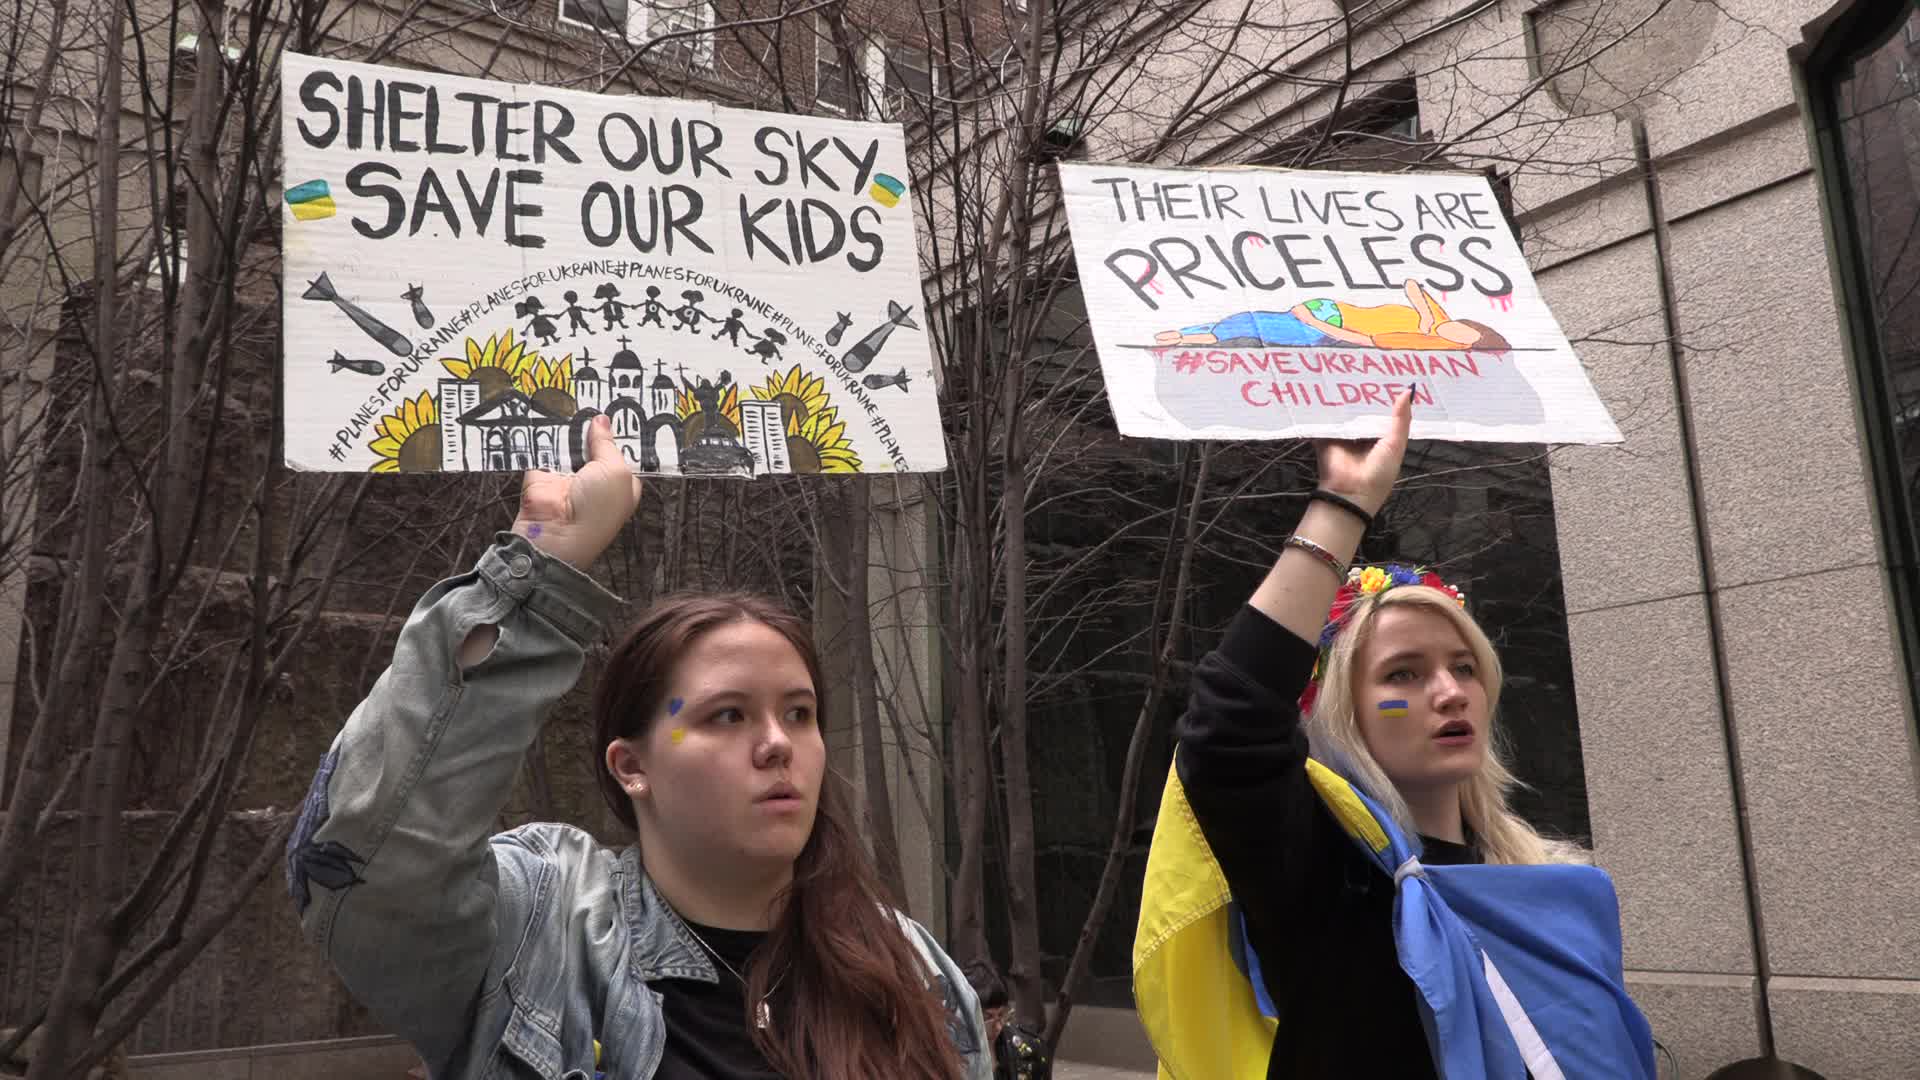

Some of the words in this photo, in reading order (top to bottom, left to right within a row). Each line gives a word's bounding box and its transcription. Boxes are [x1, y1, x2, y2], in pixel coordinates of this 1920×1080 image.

[297, 70, 583, 164] SHELTER
[599, 112, 732, 178] OUR
[754, 126, 879, 195] SKY
[346, 161, 546, 248] SAVE
[581, 181, 714, 256] OUR
[738, 193, 884, 272] KIDS
[1092, 178, 1244, 222] THEIR
[1259, 186, 1403, 232] LIVES
[1415, 193, 1497, 231] ARE
[1104, 231, 1514, 310] PRICELESS
